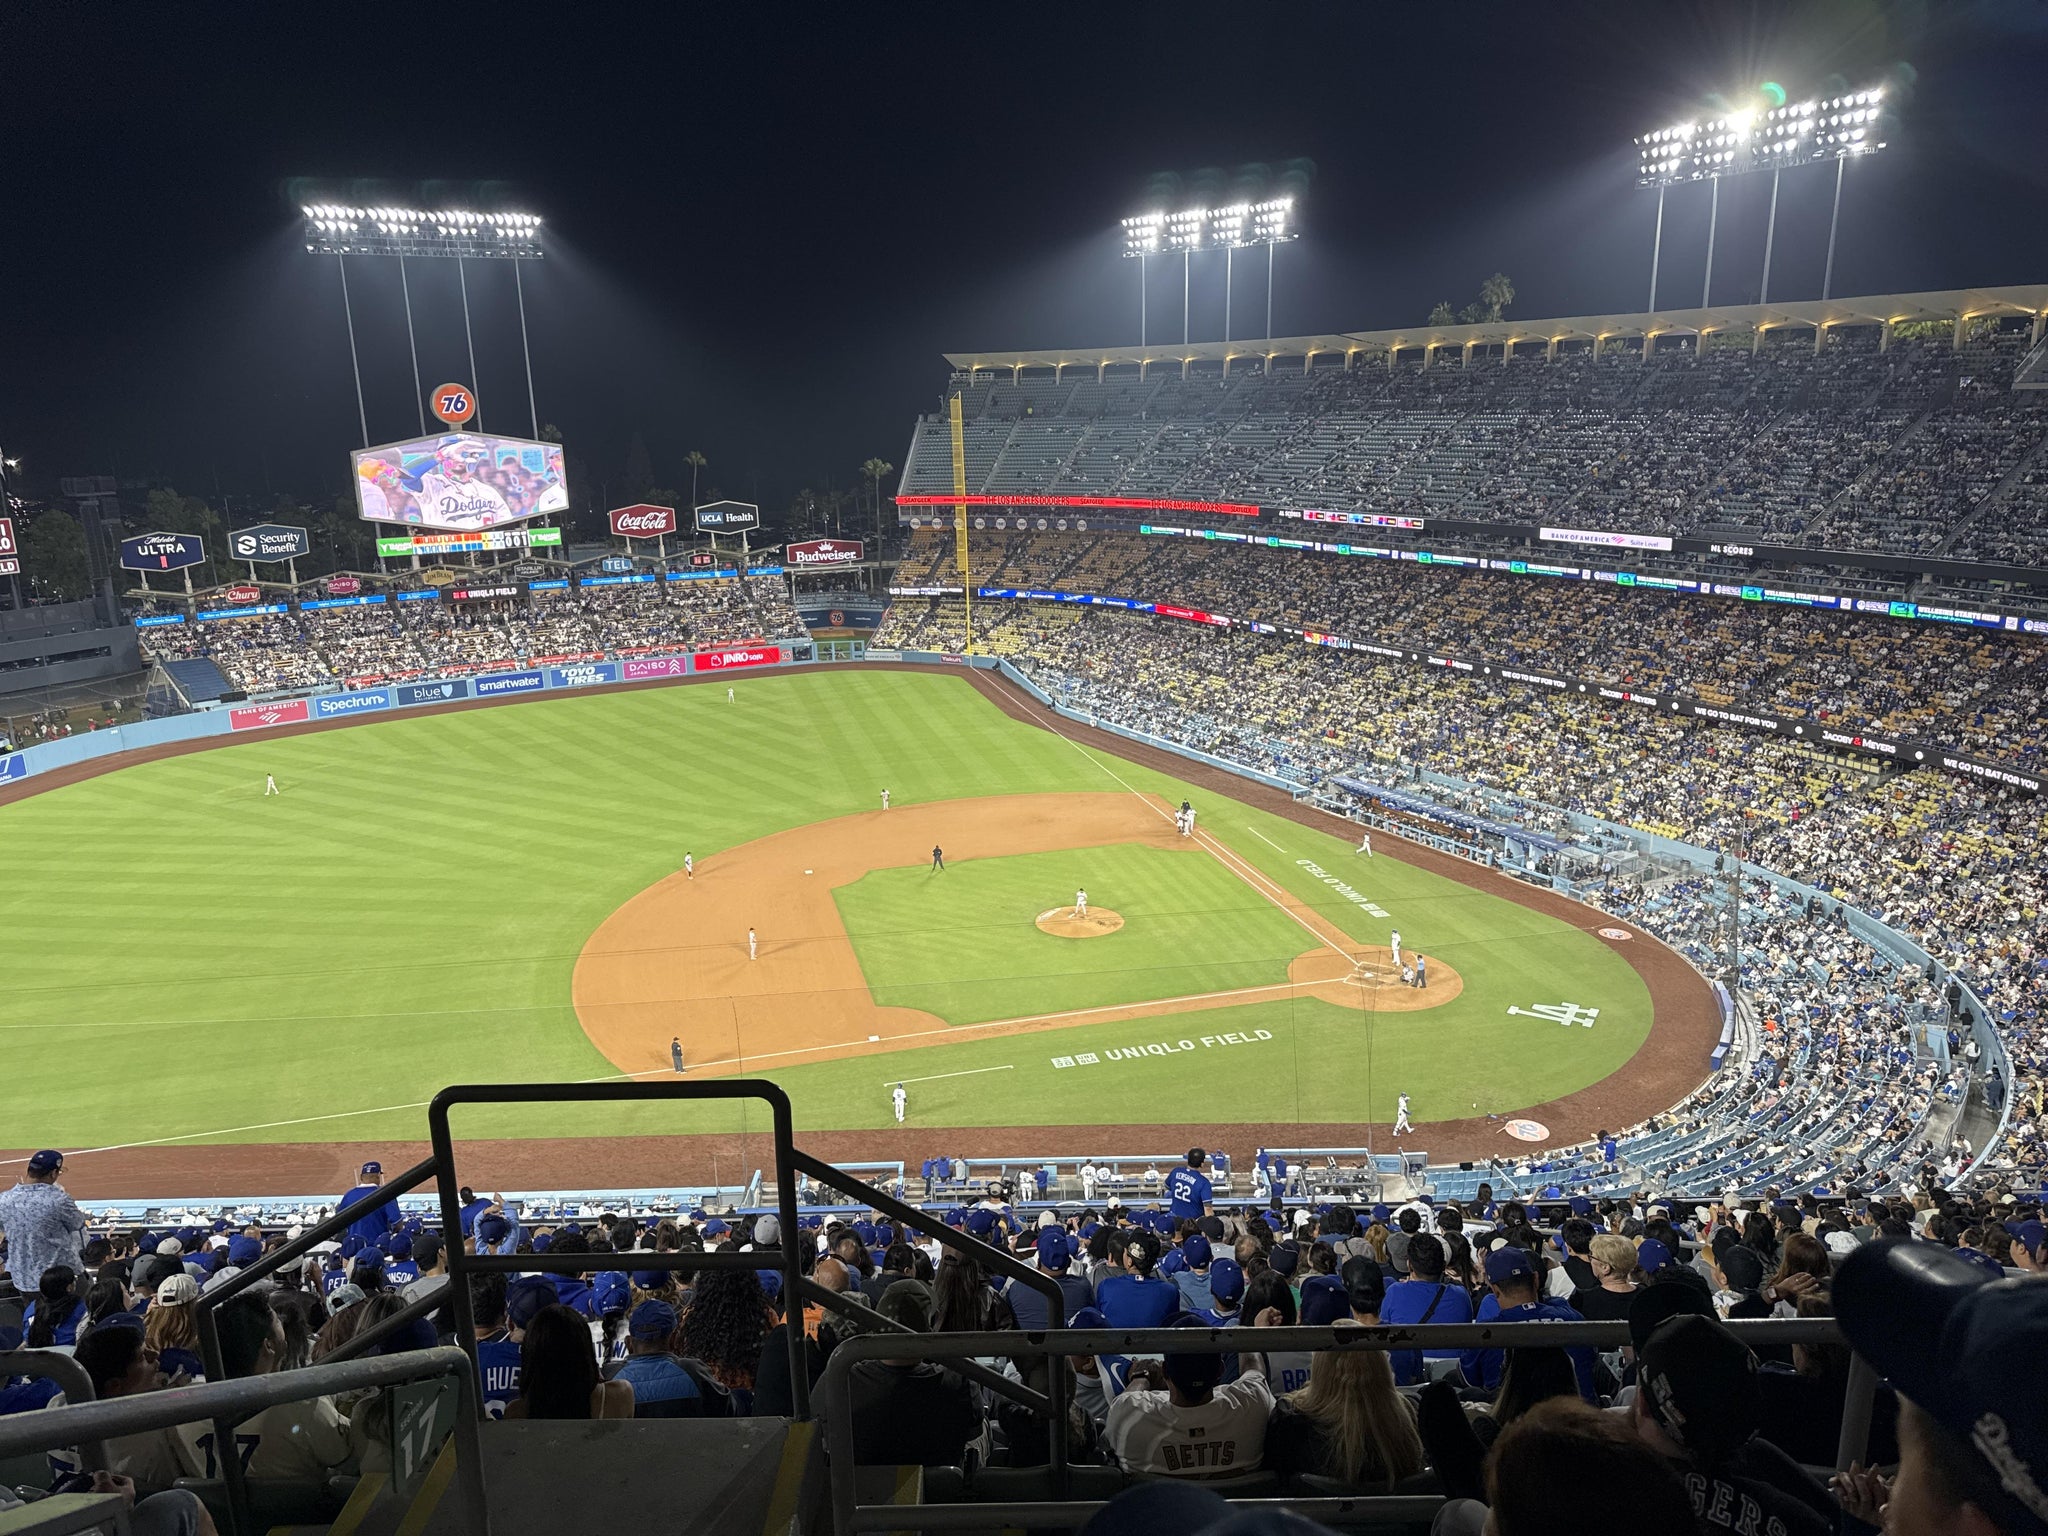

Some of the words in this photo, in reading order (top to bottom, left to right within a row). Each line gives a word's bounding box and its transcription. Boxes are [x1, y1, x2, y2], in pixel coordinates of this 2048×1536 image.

[441, 392, 468, 414] 76
[617, 511, 667, 531] Coca-Cola
[701, 514, 722, 523] UCLA
[725, 512, 754, 522] Health
[259, 532, 300, 544] Security
[1580, 535, 1610, 543] AMERICA
[138, 543, 186, 556] ULTRA
[262, 543, 297, 554] Benefit
[1711, 545, 1721, 553] NL
[1723, 545, 1753, 556] SCORES
[796, 550, 857, 562] Budweiser
[605, 559, 628, 570] TEL
[227, 591, 258, 600] Churu
[468, 589, 495, 598] UNIQLO
[496, 587, 517, 595] FIELD
[832, 613, 842, 622] 76
[722, 652, 748, 666] JINRO
[629, 661, 666, 672] DAISO
[479, 677, 540, 692] smartwater
[566, 673, 605, 685] TIRES
[1502, 670, 1511, 678] WE
[1529, 675, 1540, 683] BAT
[1541, 677, 1552, 685] FOR
[1553, 680, 1566, 688] YOU
[414, 686, 441, 698] blue
[1623, 692, 1630, 700] &
[238, 708, 257, 716] BANK
[268, 702, 299, 711] AMERICA
[321, 695, 381, 713] Spectrum
[1695, 706, 1706, 715] WE
[1708, 709, 1718, 717] GO
[1719, 711, 1729, 719] TO
[1730, 713, 1743, 723] BAT
[1745, 716, 1760, 726] FOR
[1761, 719, 1777, 729] YOU
[1823, 731, 1853, 744] JACOBY
[1853, 736, 1862, 746] &
[1863, 739, 1896, 753] MEYERS
[1944, 758, 1958, 768] WE
[1958, 762, 1971, 771] GO
[1972, 765, 1984, 774] TO
[1985, 768, 2002, 779] BAT
[2003, 773, 2019, 784] FOR
[2021, 778, 2038, 790] YOU
[1296, 859, 1329, 878] FIELD
[1323, 878, 1368, 903] UNIQLO
[1506, 1002, 1600, 1028] LA
[1104, 1039, 1196, 1061] UNIQLO
[1199, 1029, 1273, 1048] FIELD
[1176, 1172, 1197, 1185] KERSHAW
[1174, 1182, 1191, 1203] 22
[401, 1395, 440, 1480] 17
[1163, 1441, 1236, 1471] BETTS
